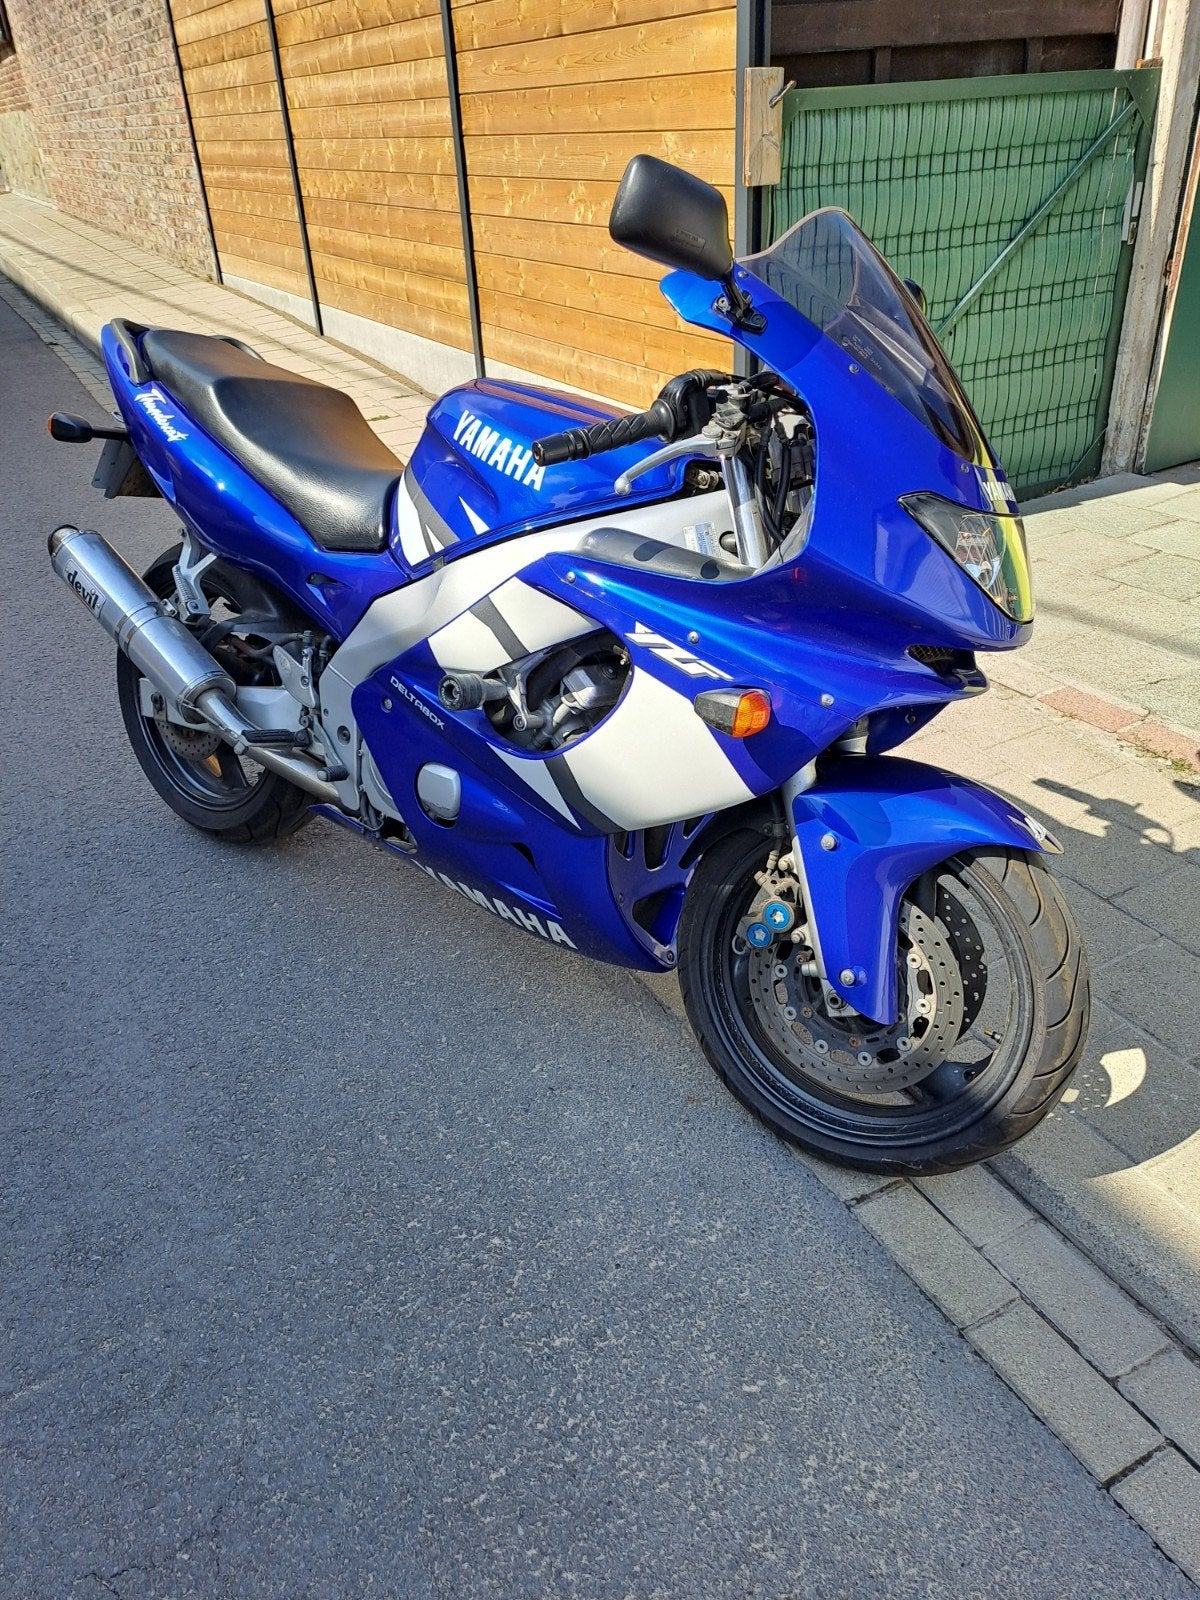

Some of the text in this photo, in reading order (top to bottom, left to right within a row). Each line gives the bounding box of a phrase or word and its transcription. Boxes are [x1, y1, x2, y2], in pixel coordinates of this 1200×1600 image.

[453, 409, 546, 491] YAMAHA
[67, 570, 99, 610] devil
[390, 675, 445, 730] DELTABOX
